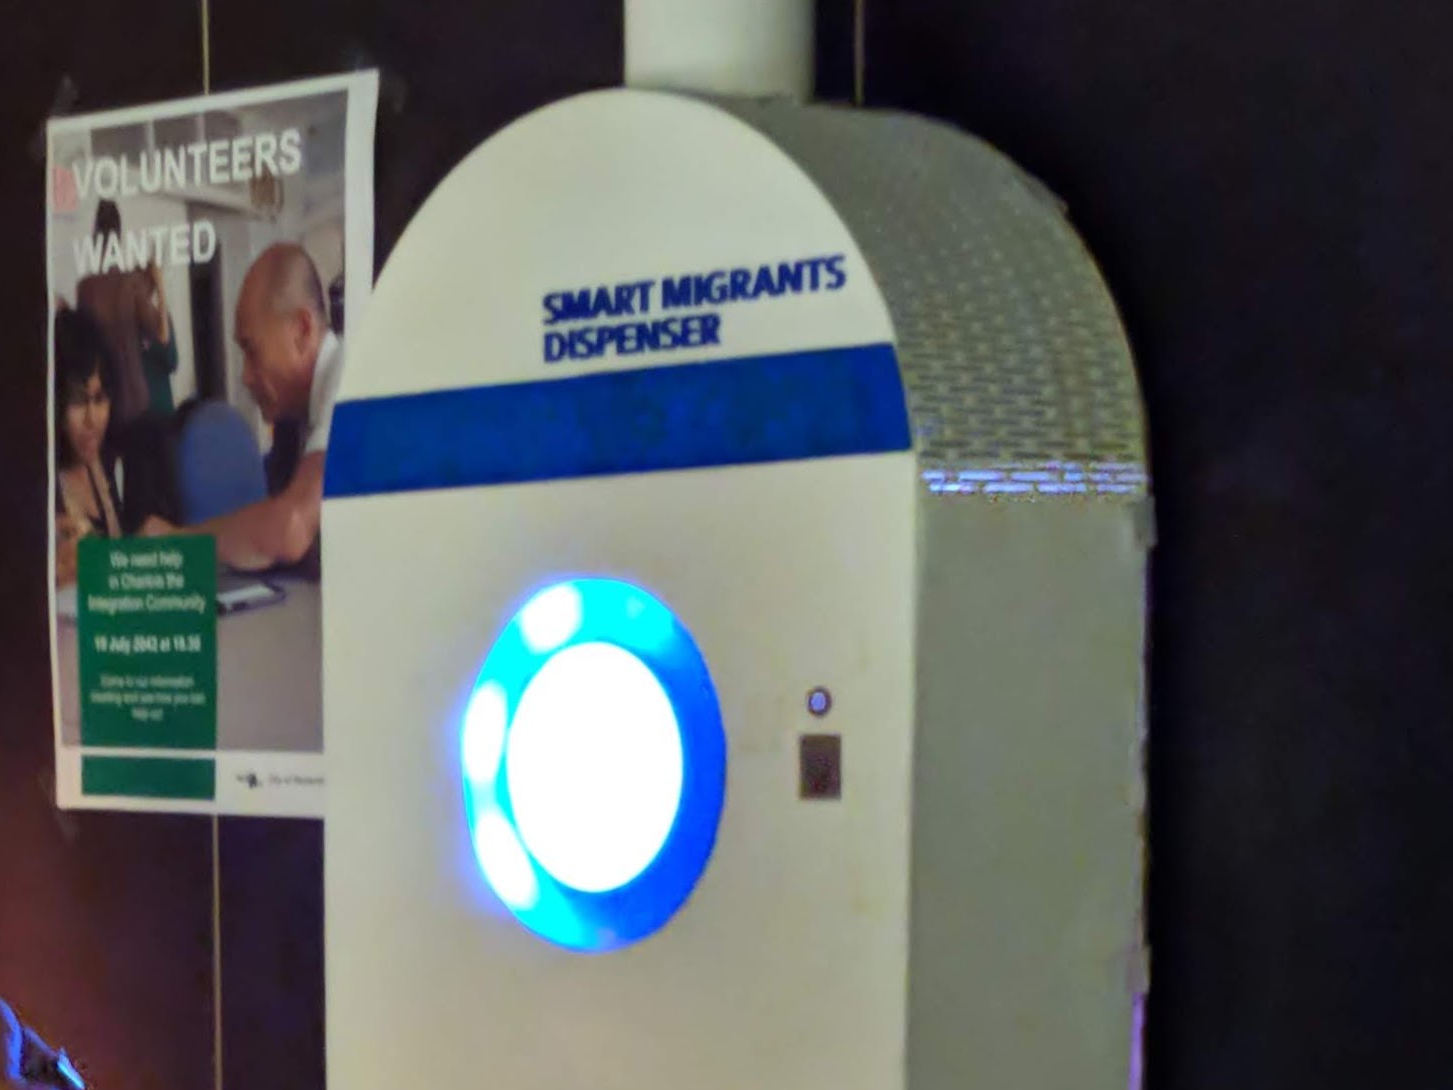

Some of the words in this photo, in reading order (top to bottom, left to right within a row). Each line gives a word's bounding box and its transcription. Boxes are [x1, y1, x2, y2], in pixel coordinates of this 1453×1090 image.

[72, 127, 302, 198] VOLUNTEERS
[72, 219, 217, 275] WANTED
[543, 279, 655, 326] SMART
[661, 253, 846, 310] MIGRANTS
[543, 312, 721, 364] DISPENSER
[109, 551, 128, 569] We
[130, 551, 158, 568] need
[159, 549, 183, 570] help
[87, 593, 145, 616] Integration
[146, 593, 206, 615] Community
